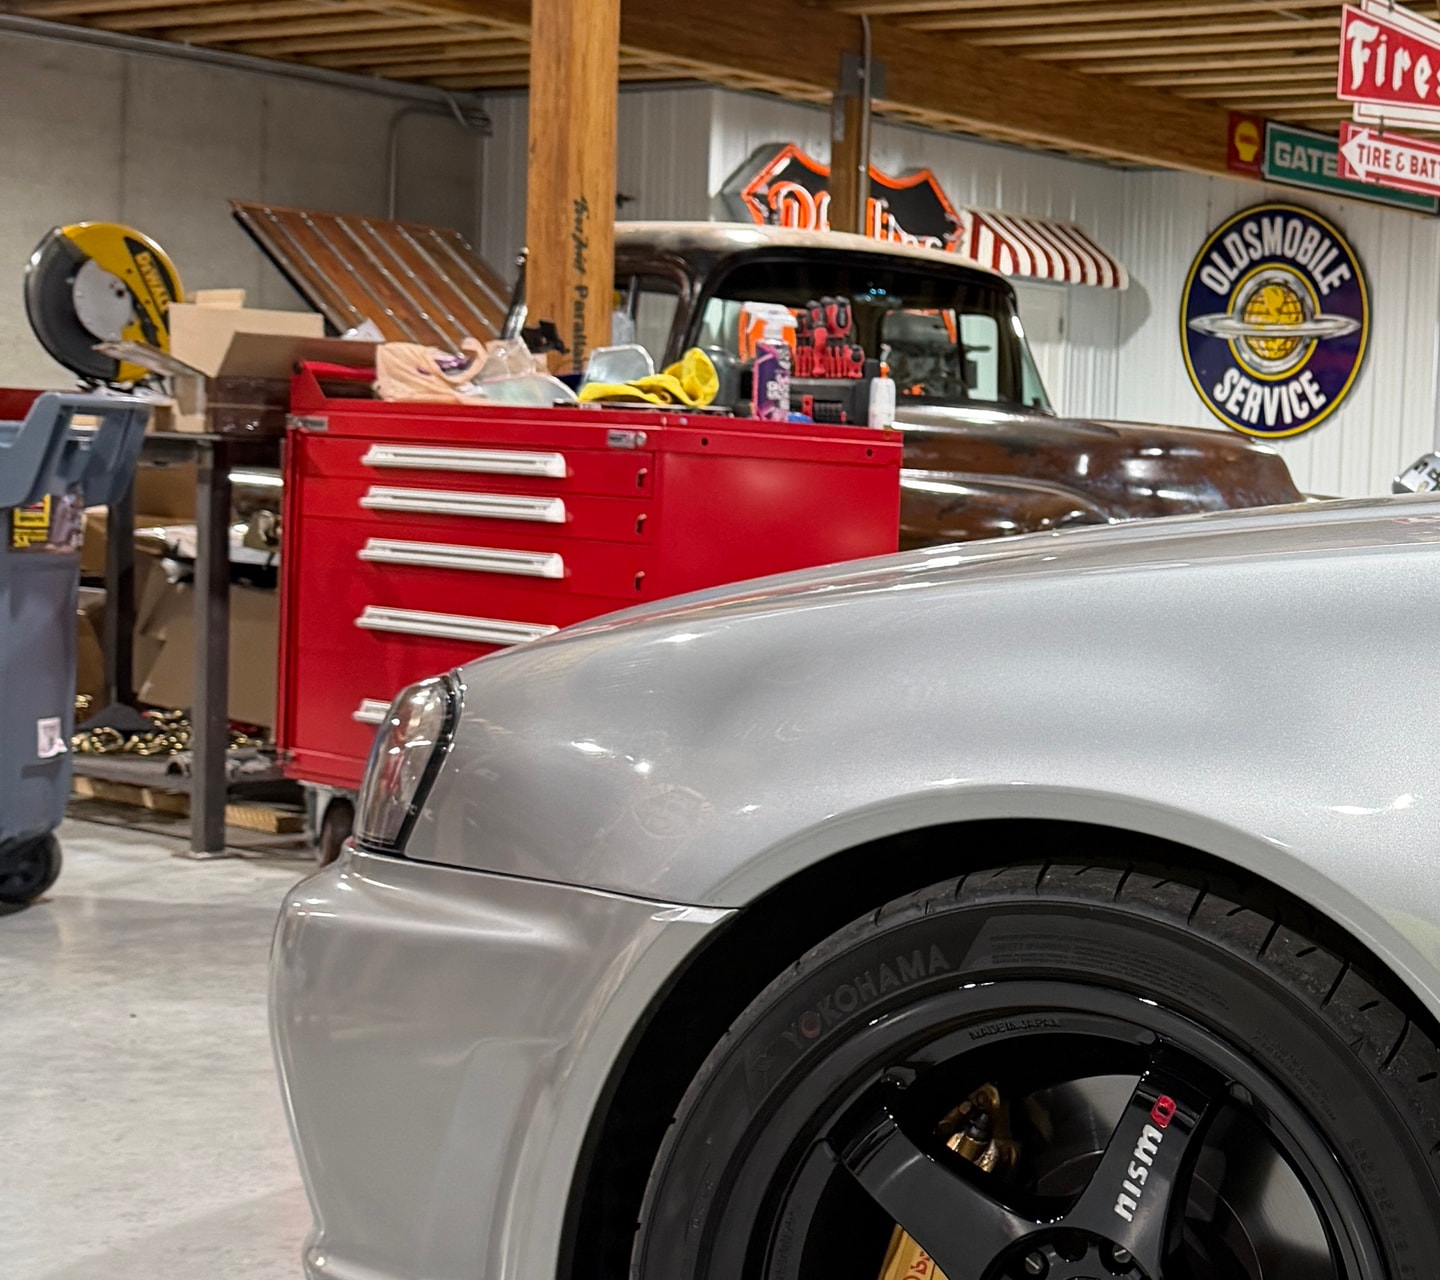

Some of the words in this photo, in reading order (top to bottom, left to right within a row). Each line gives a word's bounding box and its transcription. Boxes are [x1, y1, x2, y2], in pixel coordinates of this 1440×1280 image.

[1274, 141, 1339, 173] GATE
[1357, 143, 1390, 170] TIRE
[1395, 151, 1405, 170] &
[1201, 217, 1351, 296] OLDSMOBILE
[1213, 367, 1327, 426] SERVICE
[780, 944, 950, 1050] YOKOHAMA
[1113, 1094, 1177, 1222] nismo
